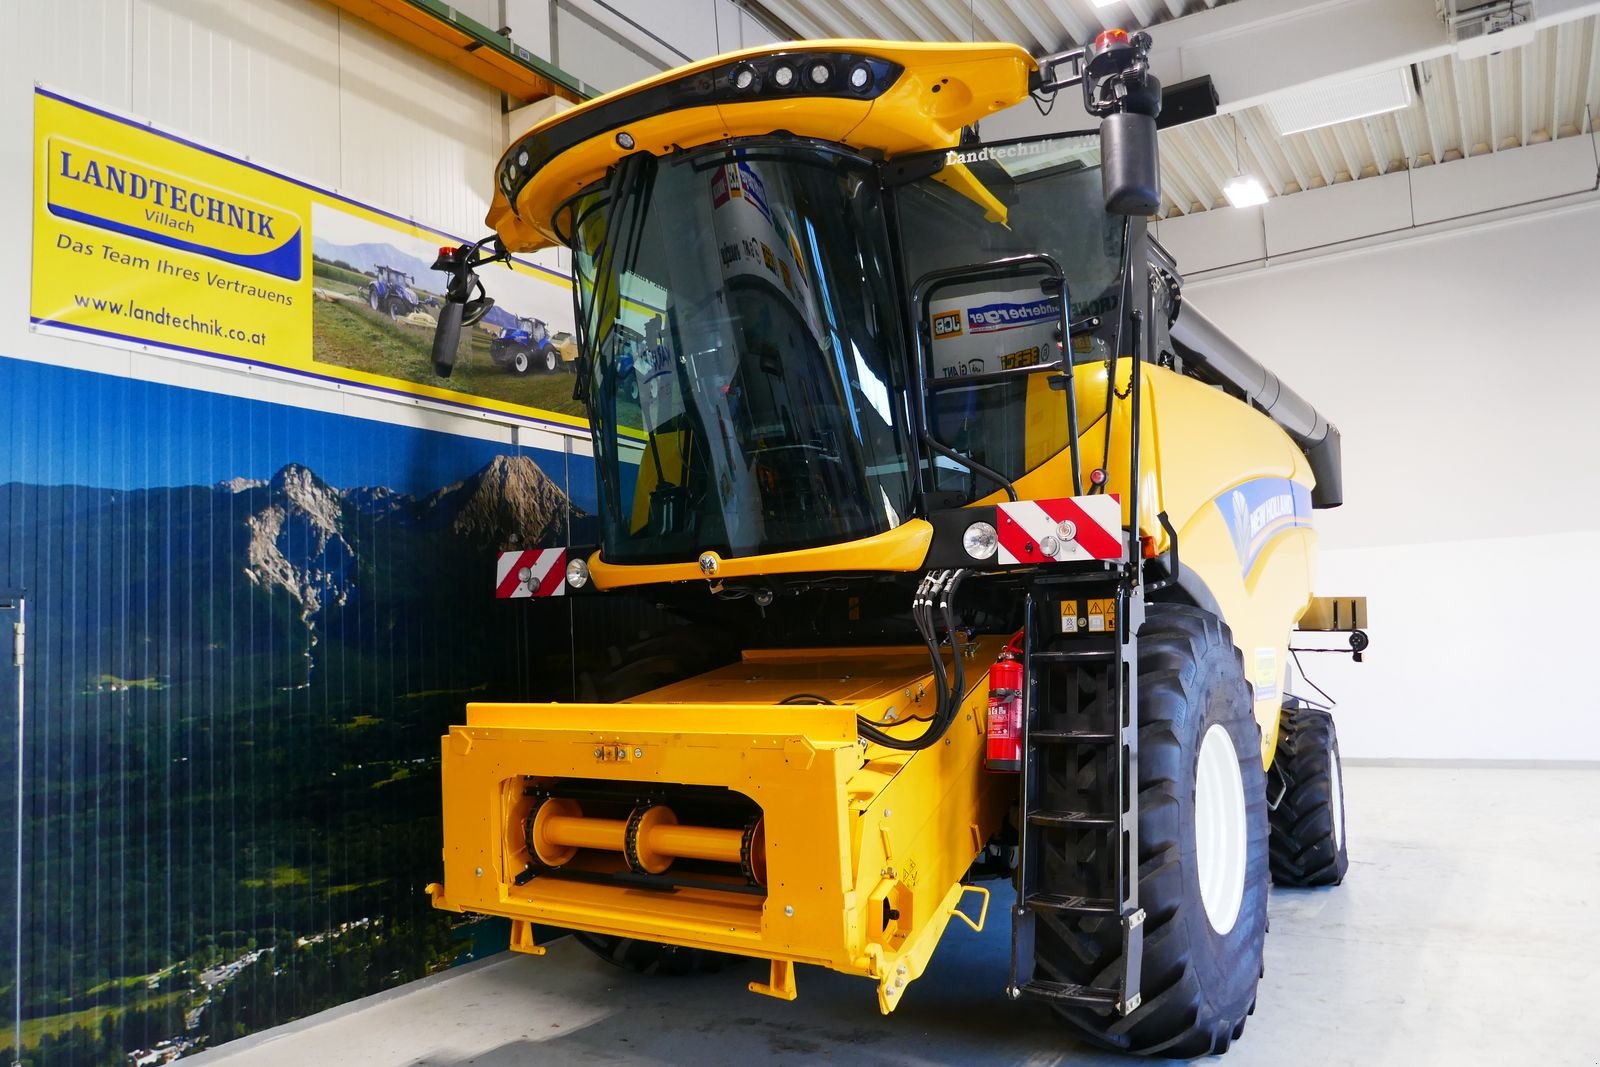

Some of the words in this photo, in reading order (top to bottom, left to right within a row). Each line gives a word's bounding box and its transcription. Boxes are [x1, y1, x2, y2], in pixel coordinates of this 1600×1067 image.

[59, 150, 276, 240] LANDTECHNIK
[144, 208, 195, 234] Villach
[56, 233, 93, 256] Das
[101, 245, 150, 270] Team
[157, 259, 200, 282] Ihres
[206, 272, 293, 307] Vertrauens
[74, 294, 267, 346] www.landtechnik.co.at
